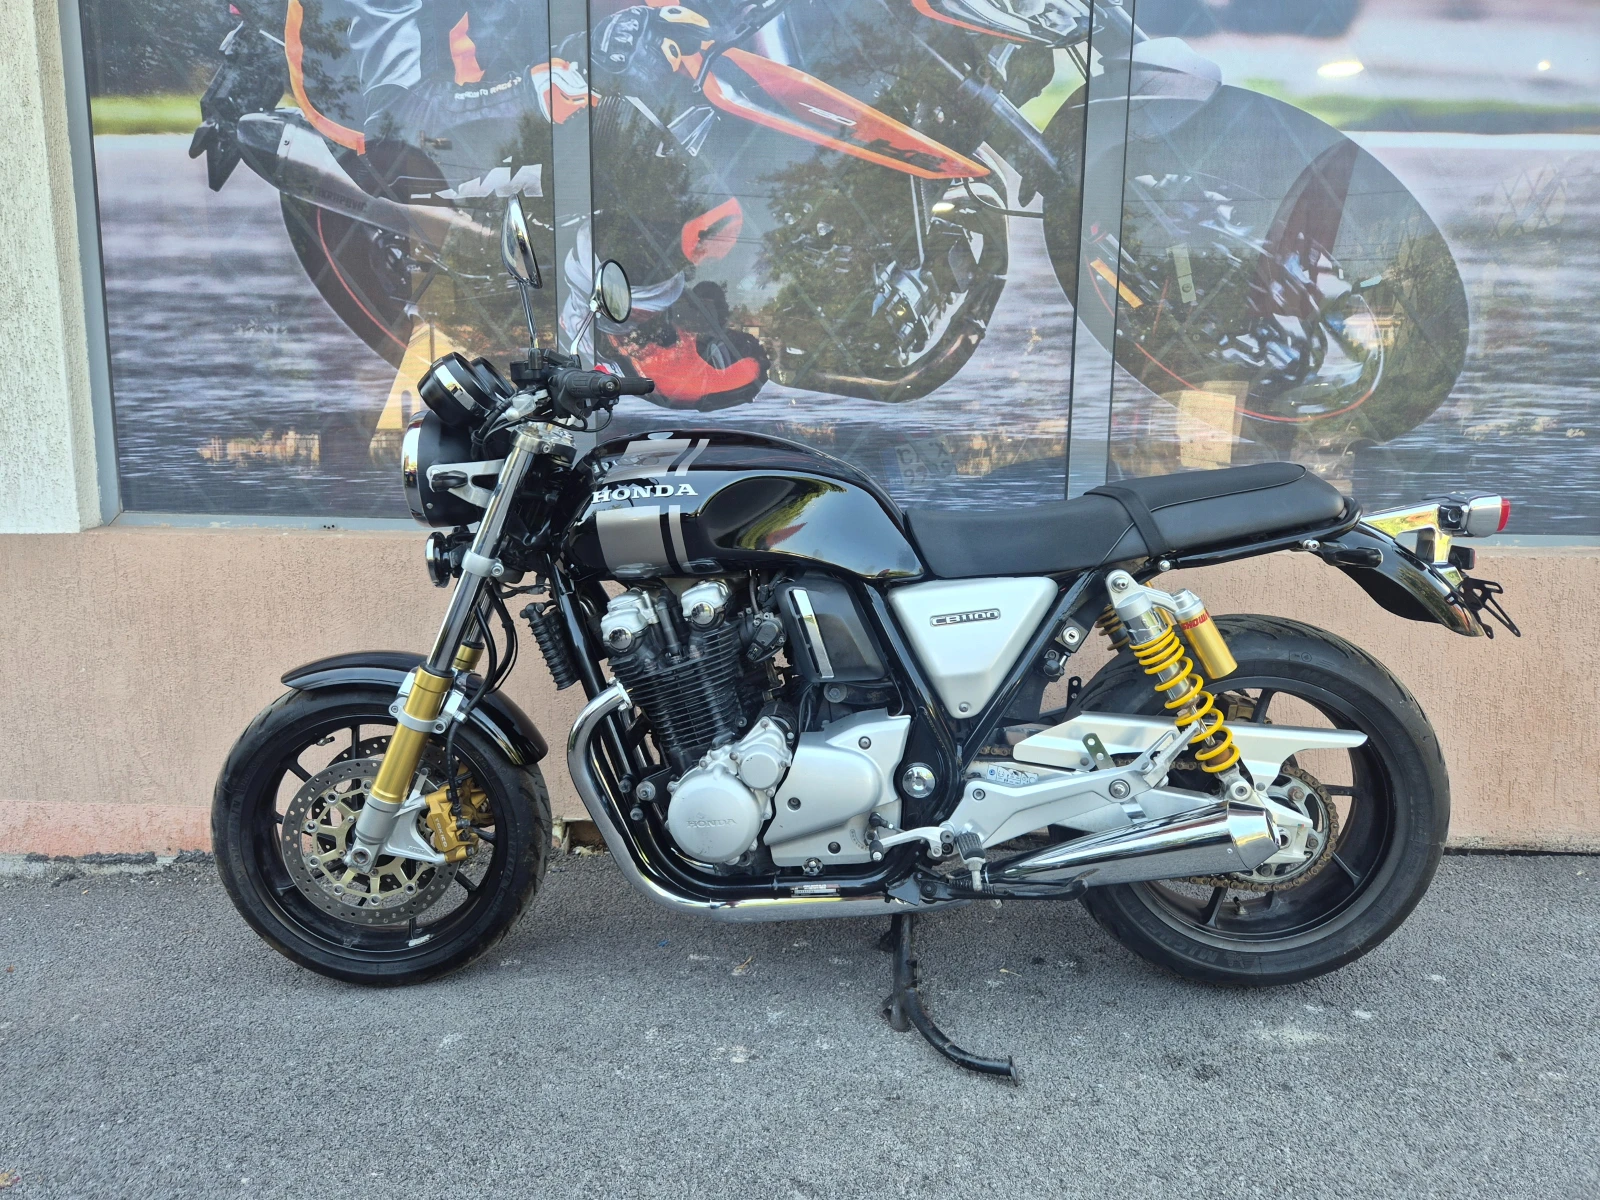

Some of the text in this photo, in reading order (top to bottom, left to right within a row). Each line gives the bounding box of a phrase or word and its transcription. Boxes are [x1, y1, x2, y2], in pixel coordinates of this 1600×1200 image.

[590, 483, 699, 504] HONDA
[931, 610, 999, 626] CB1100
[434, 817, 448, 848] TOKICO
[686, 818, 738, 829] HONDA
